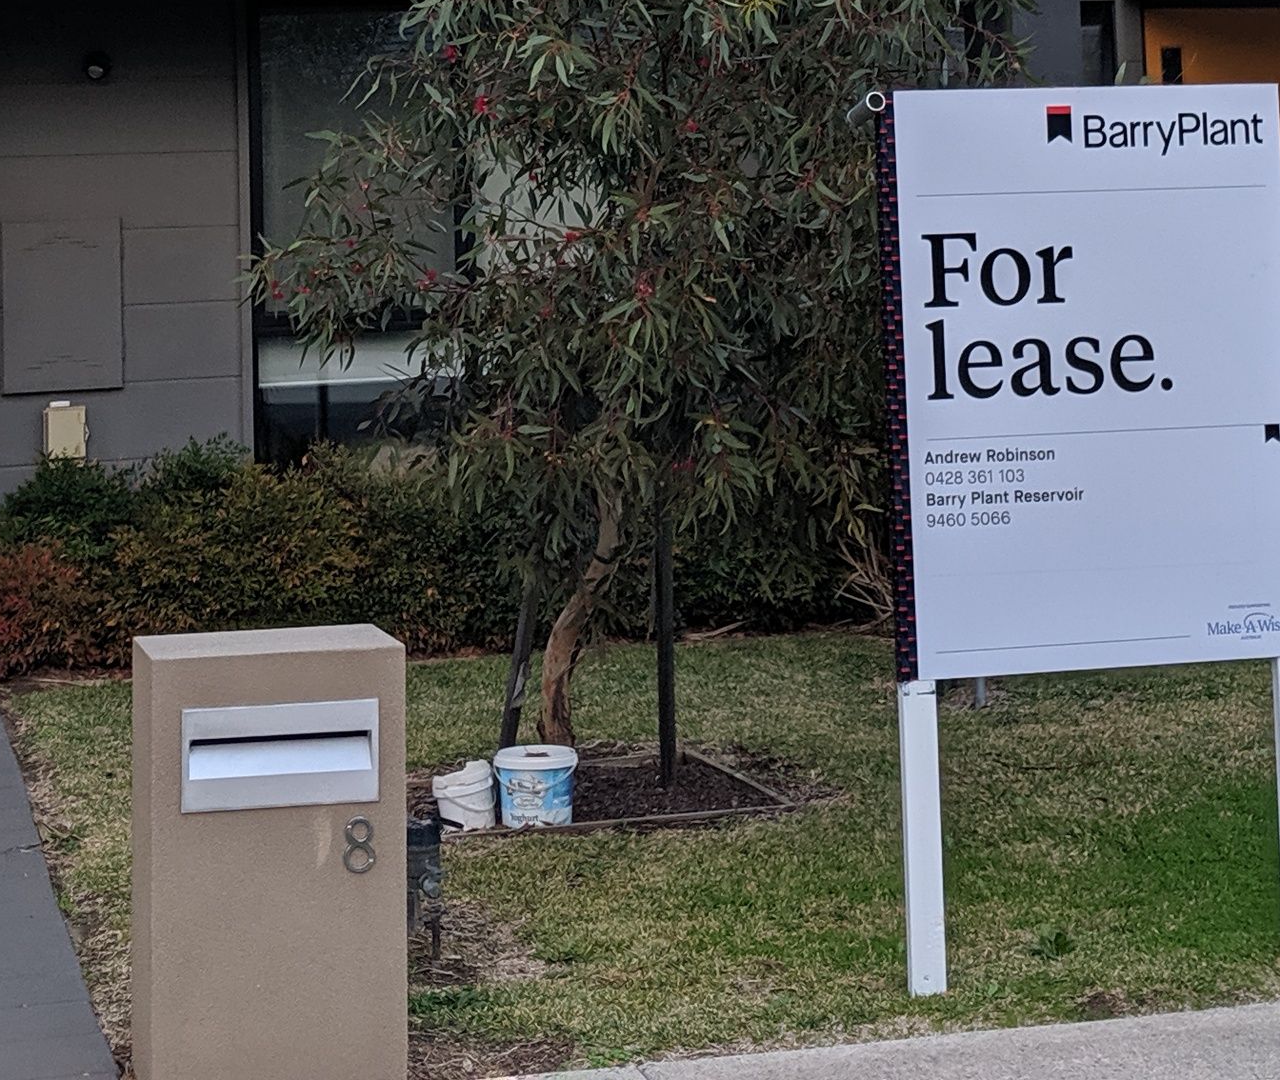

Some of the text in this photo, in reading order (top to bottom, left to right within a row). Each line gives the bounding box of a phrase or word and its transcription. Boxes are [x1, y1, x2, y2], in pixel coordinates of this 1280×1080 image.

[1083, 112, 1264, 156] BarryPlant
[920, 232, 1073, 308] For
[926, 319, 1174, 400] lease.
[924, 447, 1055, 464] Andrew Robinson
[925, 468, 1025, 486] 0428 361 103
[926, 487, 1084, 509] Barry Plant Reservoir
[926, 511, 1011, 528] 9460 5066
